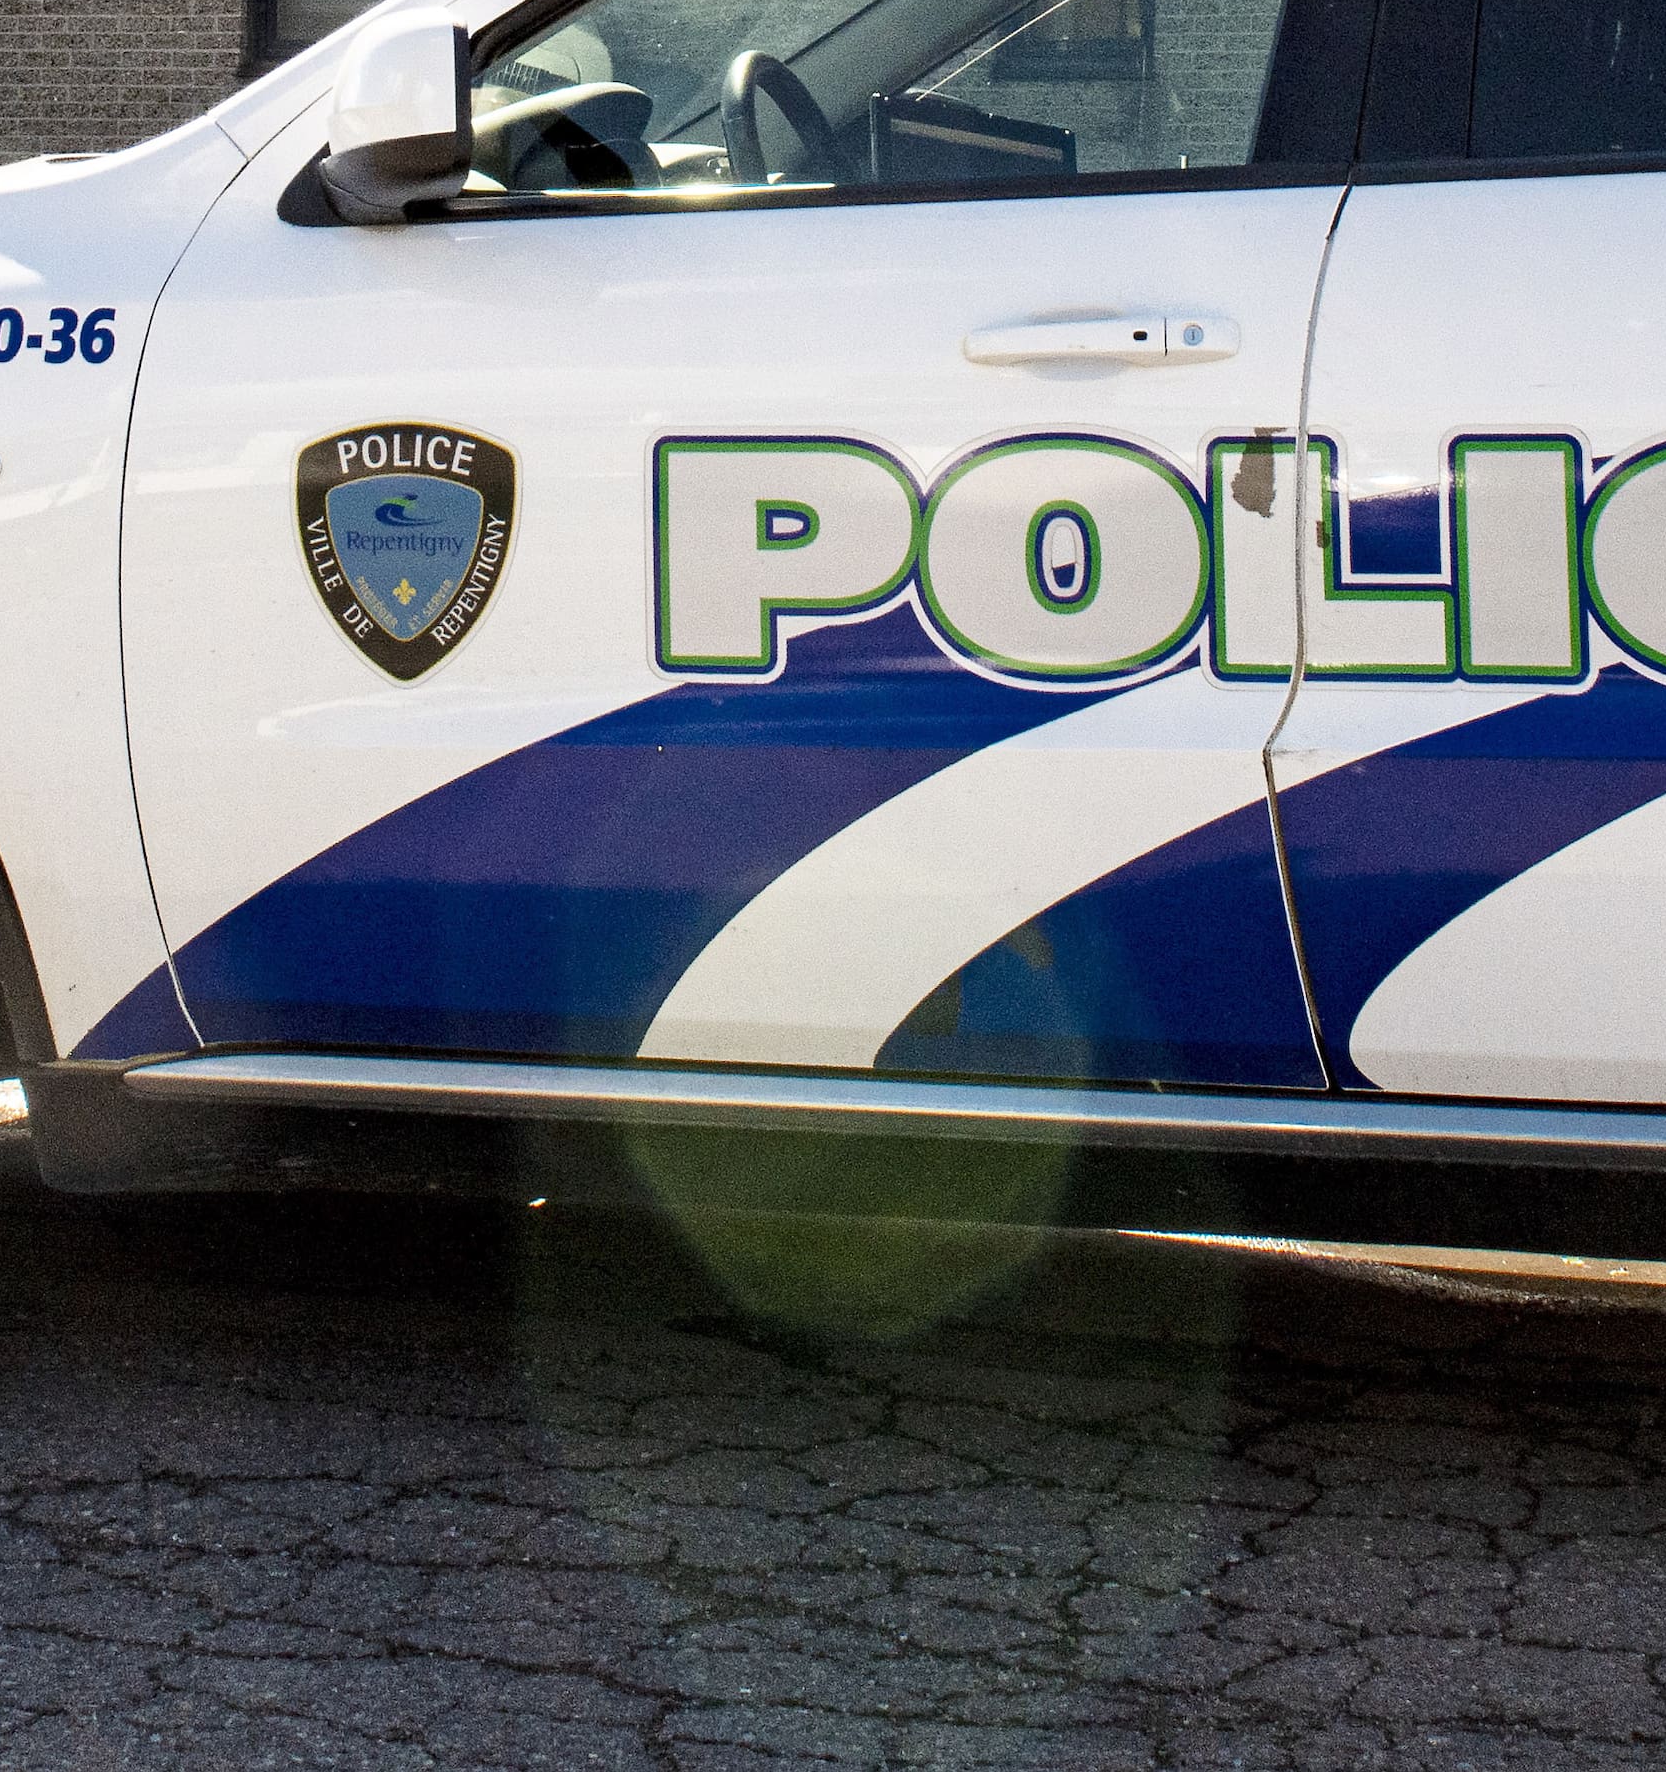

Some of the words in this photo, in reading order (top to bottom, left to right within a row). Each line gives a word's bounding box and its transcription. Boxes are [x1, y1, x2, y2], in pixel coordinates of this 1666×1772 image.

[337, 434, 476, 475] POLICE
[346, 531, 465, 556] Repentigny
[307, 516, 343, 592] VILLE
[342, 603, 374, 639] DE
[431, 514, 507, 646] REPENTIGNY
